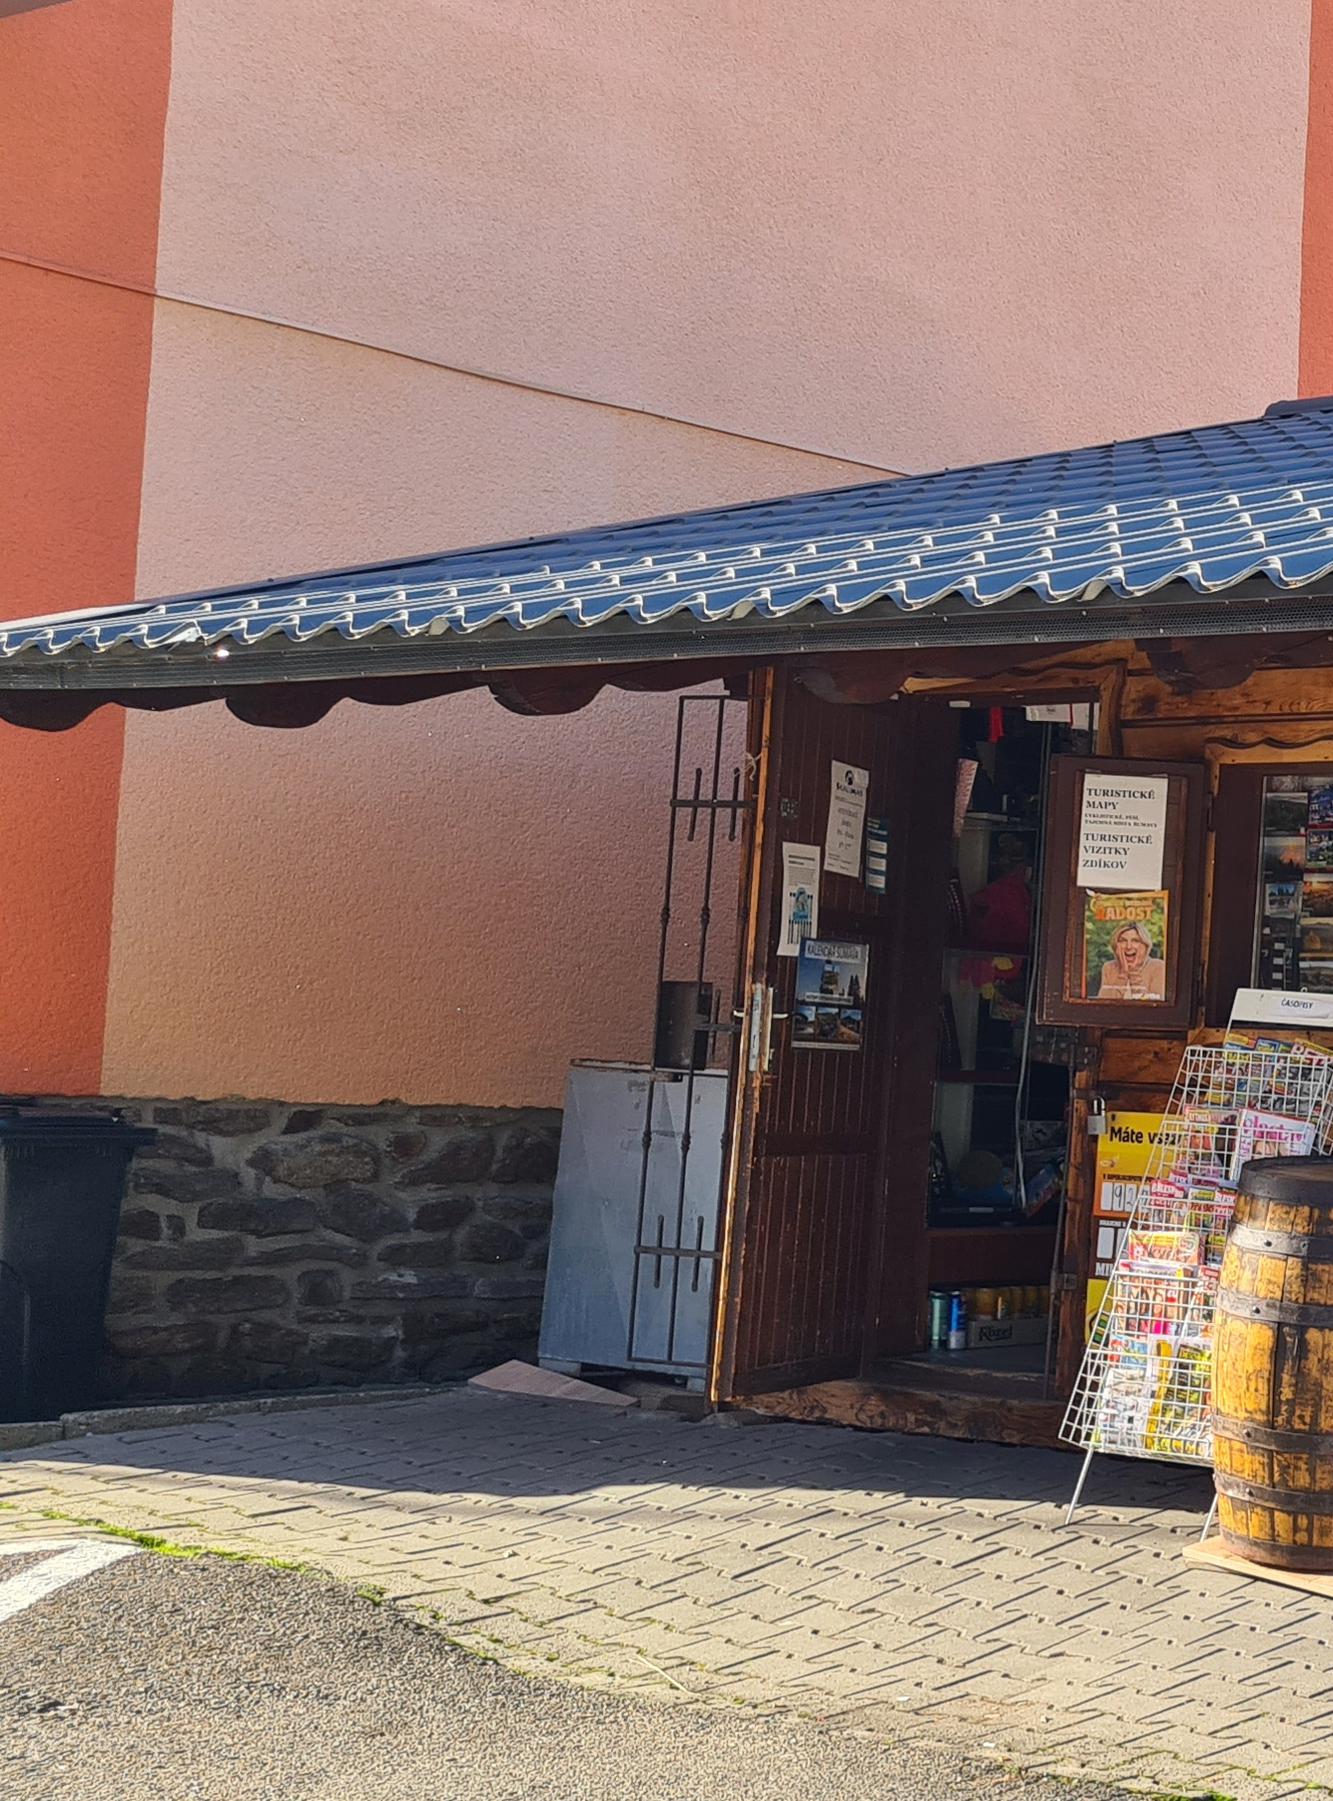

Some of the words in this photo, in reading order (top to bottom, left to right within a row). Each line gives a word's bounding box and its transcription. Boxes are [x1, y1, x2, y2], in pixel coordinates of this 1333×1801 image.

[1086, 788, 1155, 799] TURISTICKÉ
[1086, 801, 1119, 810] MAPY
[1083, 833, 1153, 845] TURISTICKÉ
[1083, 845, 1130, 856] VIZITKY
[1082, 859, 1127, 870] ZDÍKOV
[1110, 1126, 1144, 1145] Máte
